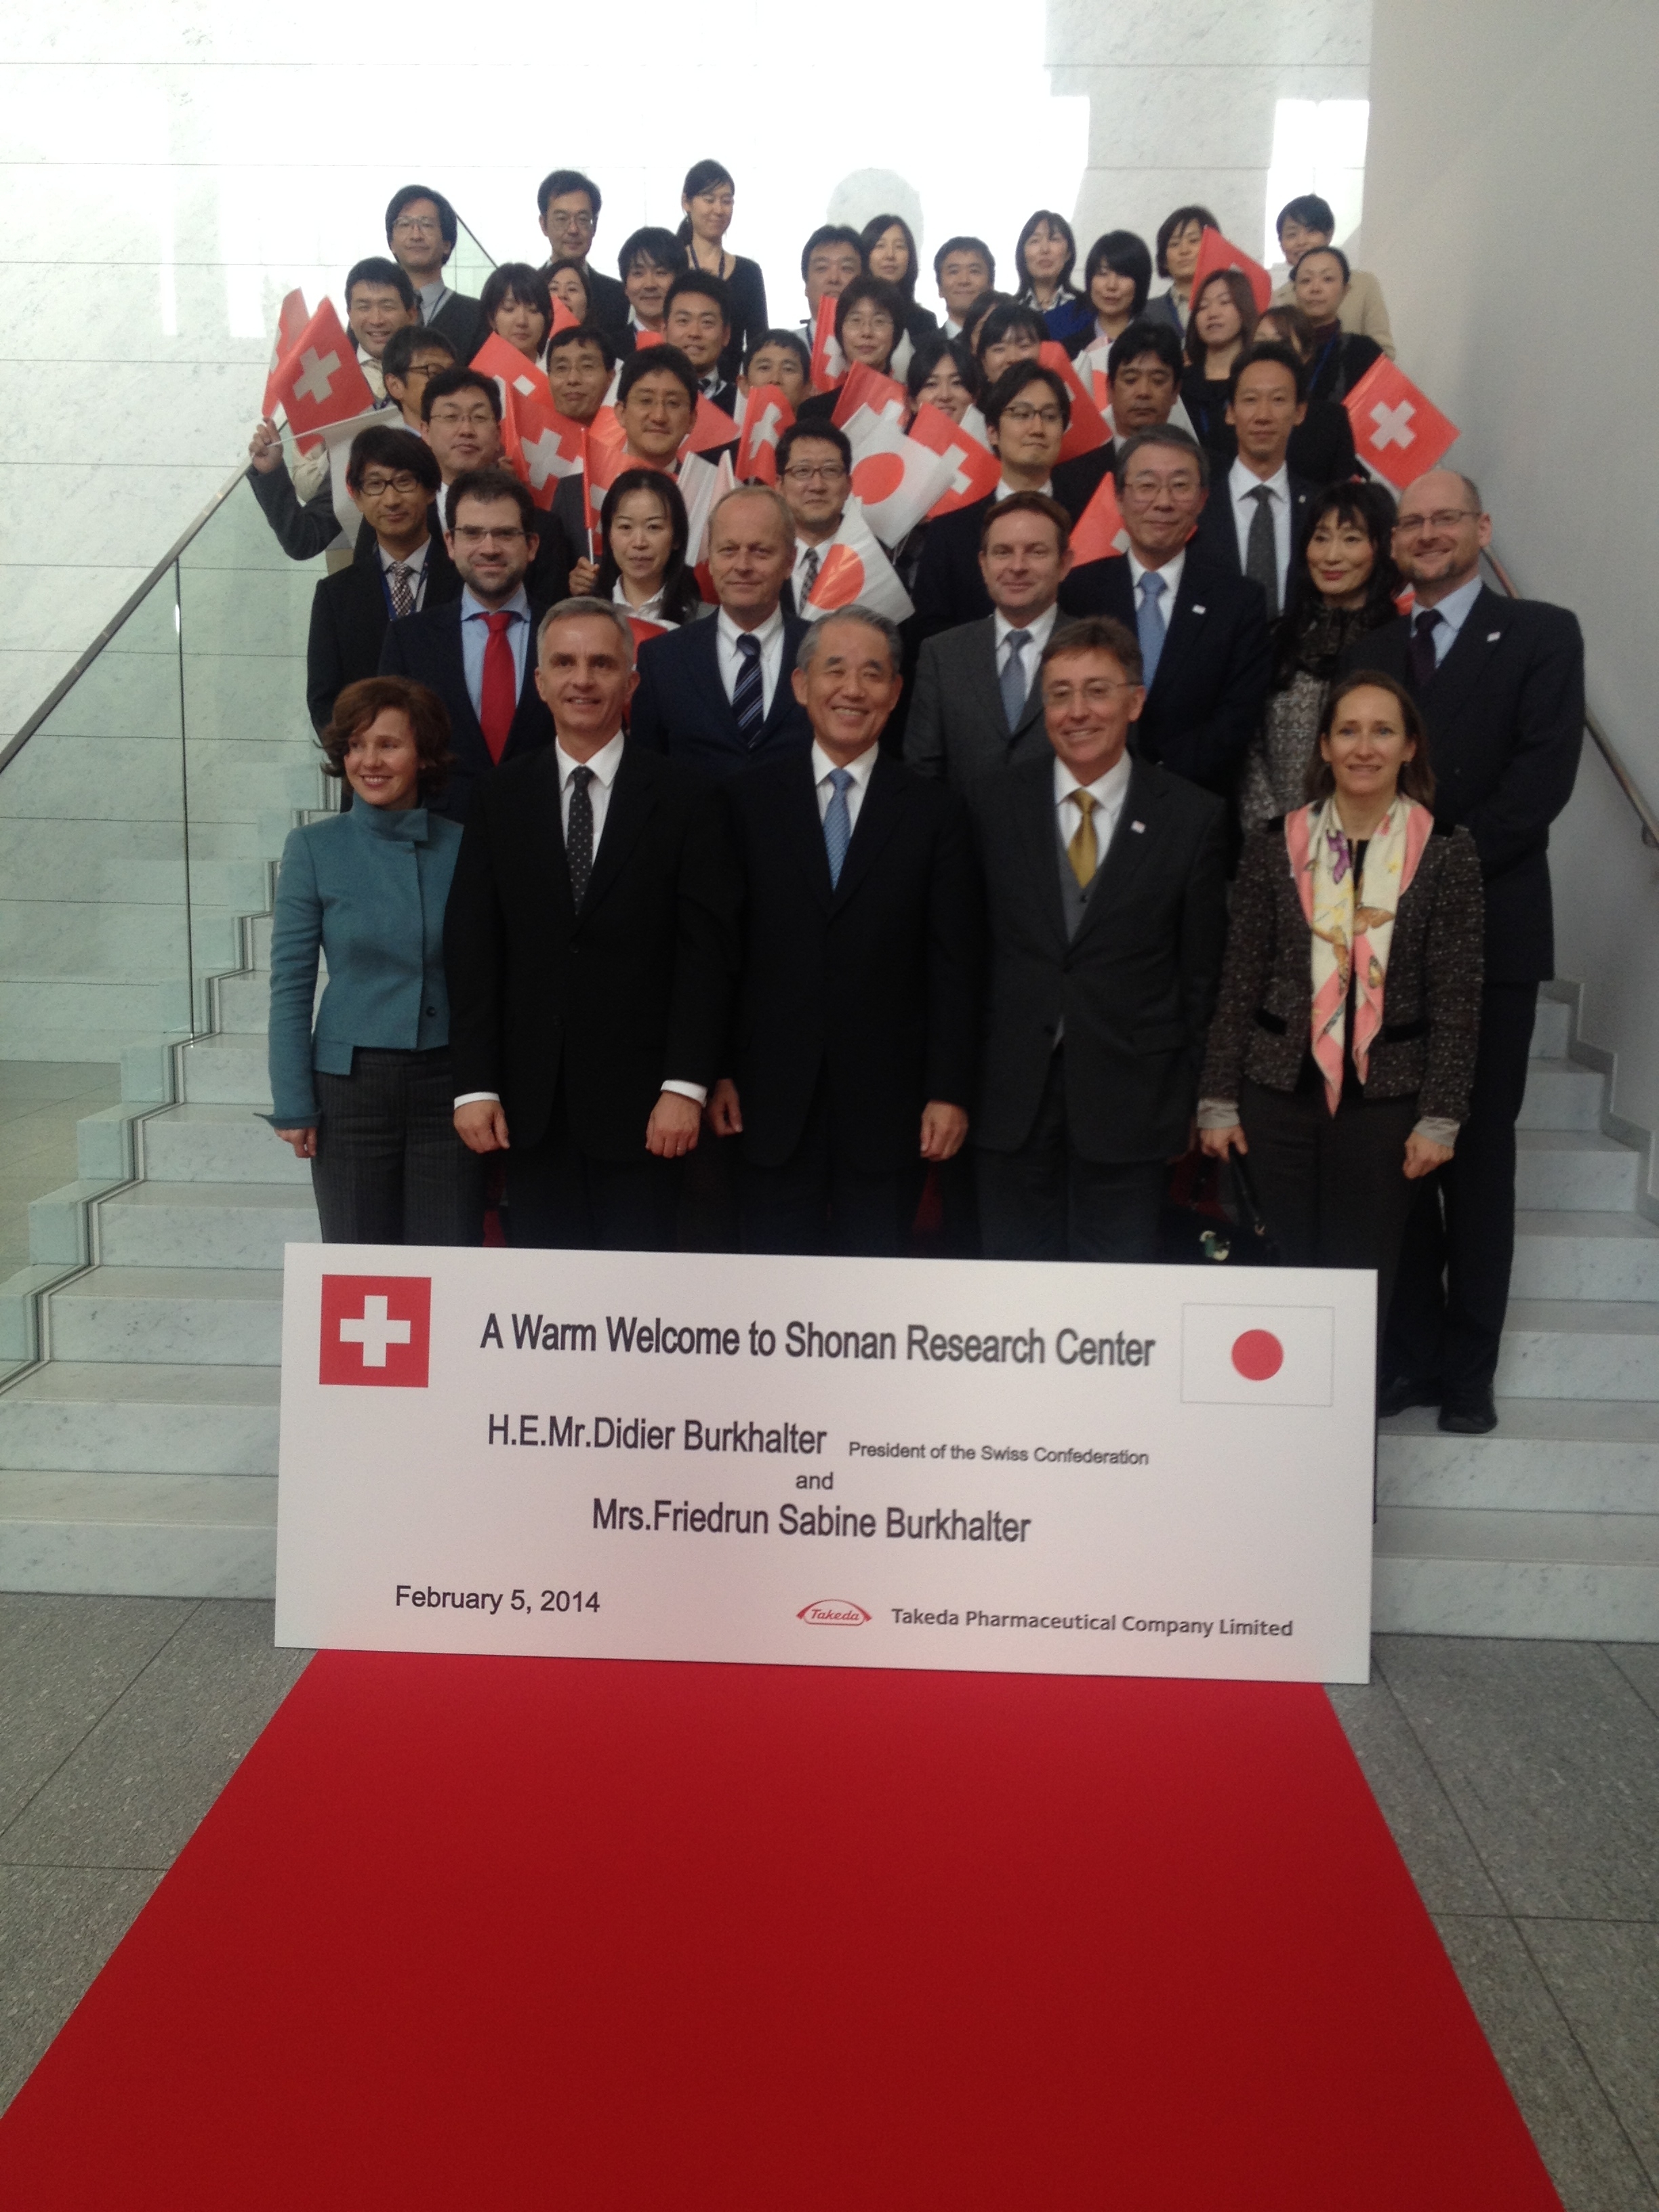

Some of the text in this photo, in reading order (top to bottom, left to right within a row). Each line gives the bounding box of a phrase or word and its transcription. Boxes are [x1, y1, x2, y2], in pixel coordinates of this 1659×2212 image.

[480, 1313, 1156, 1366] A Warm Welcome to Shonan Research Center
[489, 1414, 827, 1454] H.E.Mr.Didier Burkhalter
[849, 1441, 1149, 1465] President of the Swiss Confederation
[796, 1471, 834, 1490] and
[593, 1498, 1031, 1542] Mrs.Friedrun Sabine Burkhalter
[396, 1585, 600, 1615] February 5, 2014
[811, 1608, 859, 1621] Takeda
[891, 1608, 1293, 1638] Takeda Pharmaceutical Company Limited
